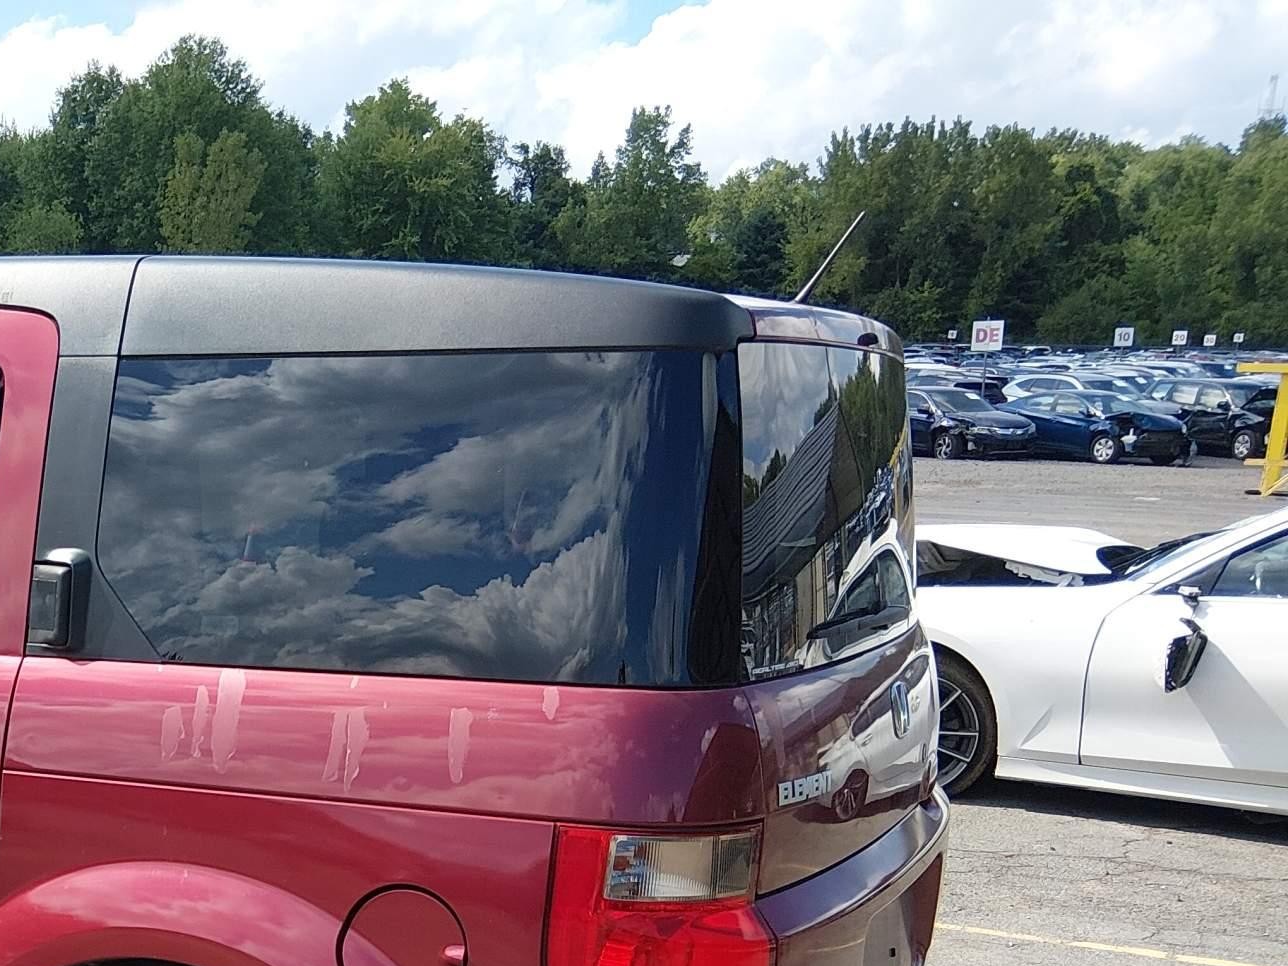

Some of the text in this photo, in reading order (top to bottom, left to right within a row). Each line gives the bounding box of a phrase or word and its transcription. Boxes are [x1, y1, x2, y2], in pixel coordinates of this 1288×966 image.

[975, 327, 1000, 344] DE
[1117, 332, 1130, 342] 10
[1174, 334, 1185, 342] 20
[777, 769, 832, 807] ELEMENT
